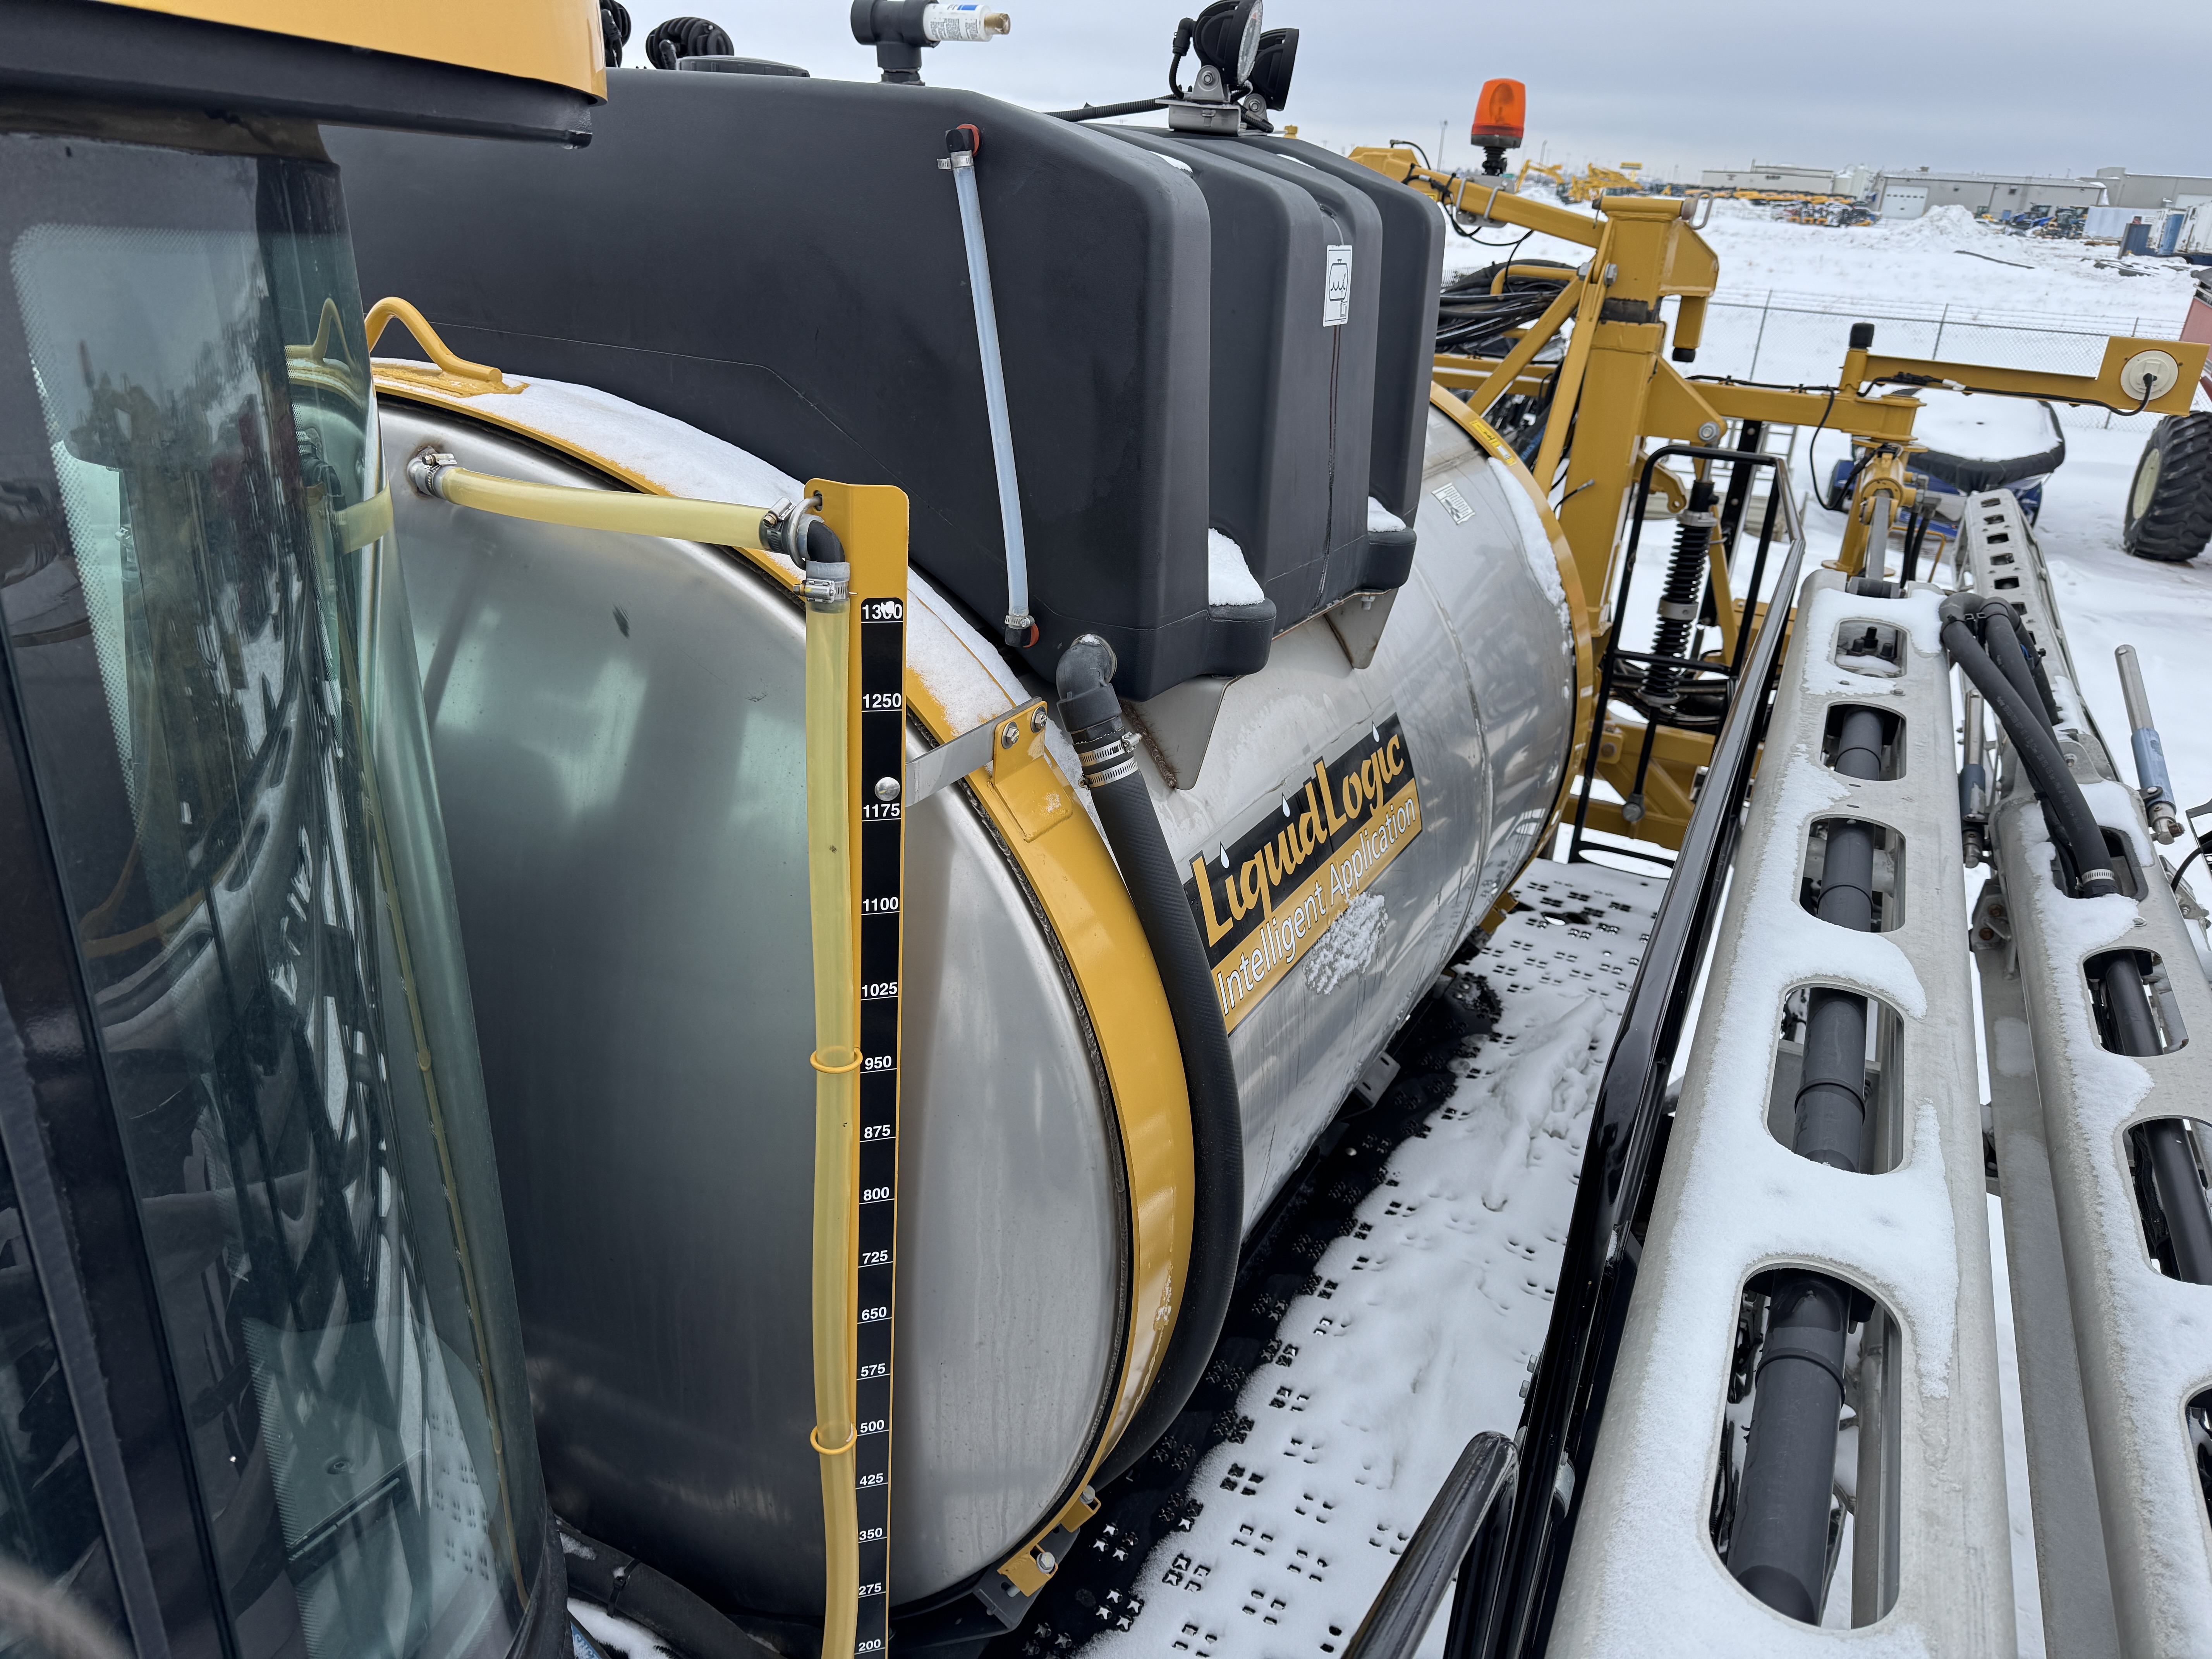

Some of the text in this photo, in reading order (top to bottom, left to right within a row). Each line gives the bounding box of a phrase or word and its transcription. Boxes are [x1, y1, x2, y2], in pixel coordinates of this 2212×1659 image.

[863, 693, 902, 708] 1250
[863, 803, 900, 818] 1175
[1192, 721, 1404, 947] LiquidLogic
[863, 897, 898, 912] 1100
[1217, 796, 1417, 1015] Intelligent Application
[862, 982, 897, 997] 1025
[865, 1055, 892, 1070] 950
[864, 1124, 891, 1139] 875
[863, 1187, 890, 1201] 800
[862, 1250, 888, 1264] 725
[861, 1306, 887, 1321] 650
[860, 1363, 886, 1377] 575
[860, 1420, 884, 1433] 500
[859, 1473, 883, 1486] 425
[859, 1527, 883, 1540] 350
[859, 1582, 881, 1595] 275
[858, 1639, 881, 1652] 200
